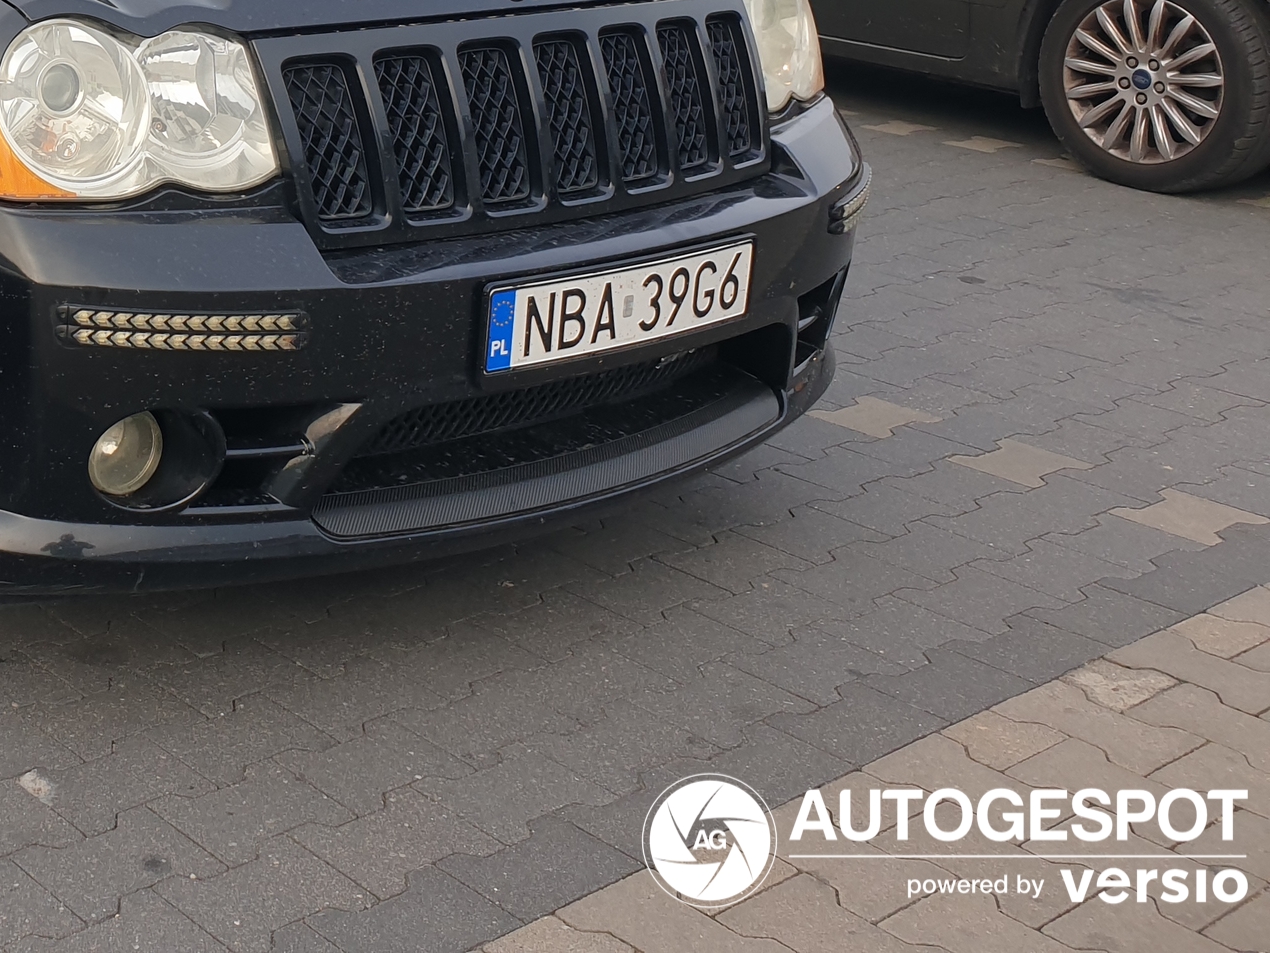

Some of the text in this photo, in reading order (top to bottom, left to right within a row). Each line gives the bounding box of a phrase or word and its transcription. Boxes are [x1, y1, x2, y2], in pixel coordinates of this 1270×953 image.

[522, 250, 743, 358] NBA 39G6
[490, 339, 509, 358] PL
